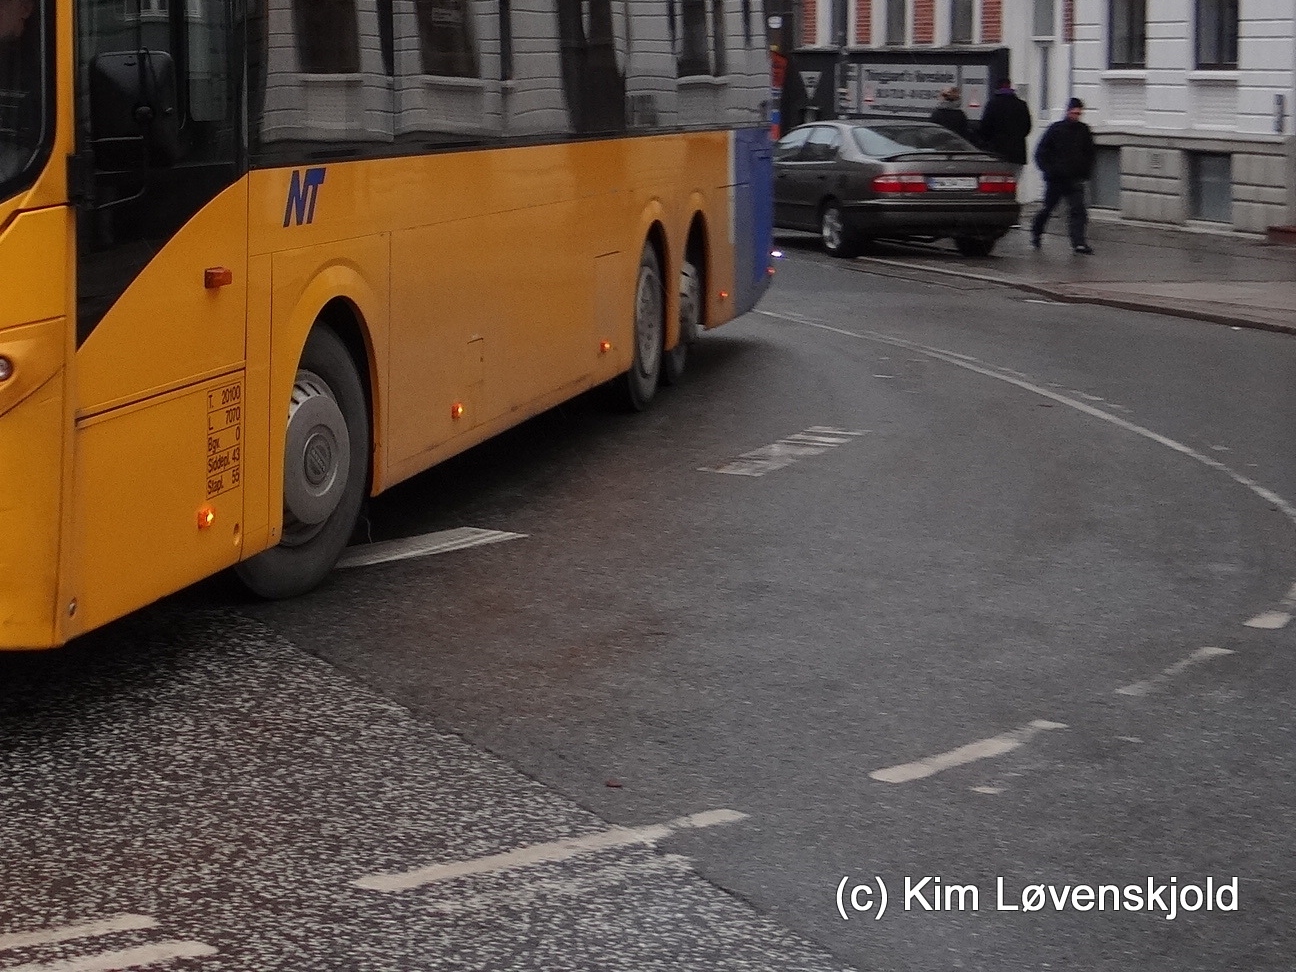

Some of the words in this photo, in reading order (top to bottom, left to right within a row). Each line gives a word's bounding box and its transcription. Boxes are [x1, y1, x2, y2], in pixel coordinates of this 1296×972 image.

[283, 167, 326, 228] NT
[221, 385, 241, 405] 20100
[225, 406, 241, 425] 7070
[235, 426, 241, 441] 0
[231, 447, 241, 463] 43
[231, 468, 240, 485] 55
